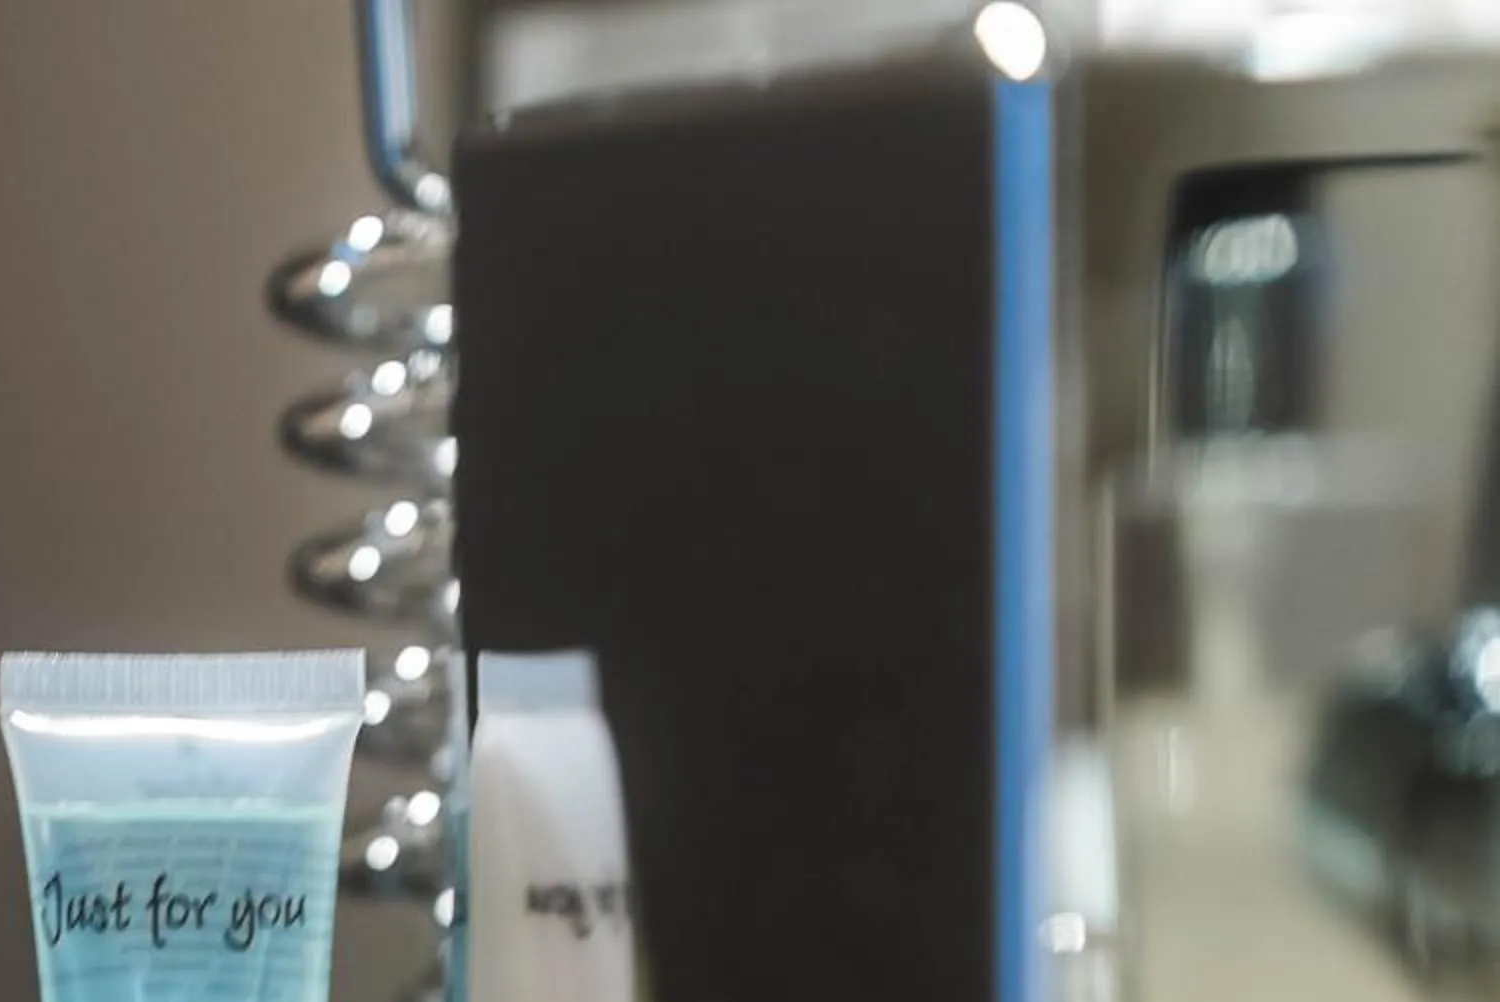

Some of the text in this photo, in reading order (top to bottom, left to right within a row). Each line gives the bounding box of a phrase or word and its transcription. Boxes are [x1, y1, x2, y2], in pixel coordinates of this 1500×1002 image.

[40, 872, 306, 953] Just for you
